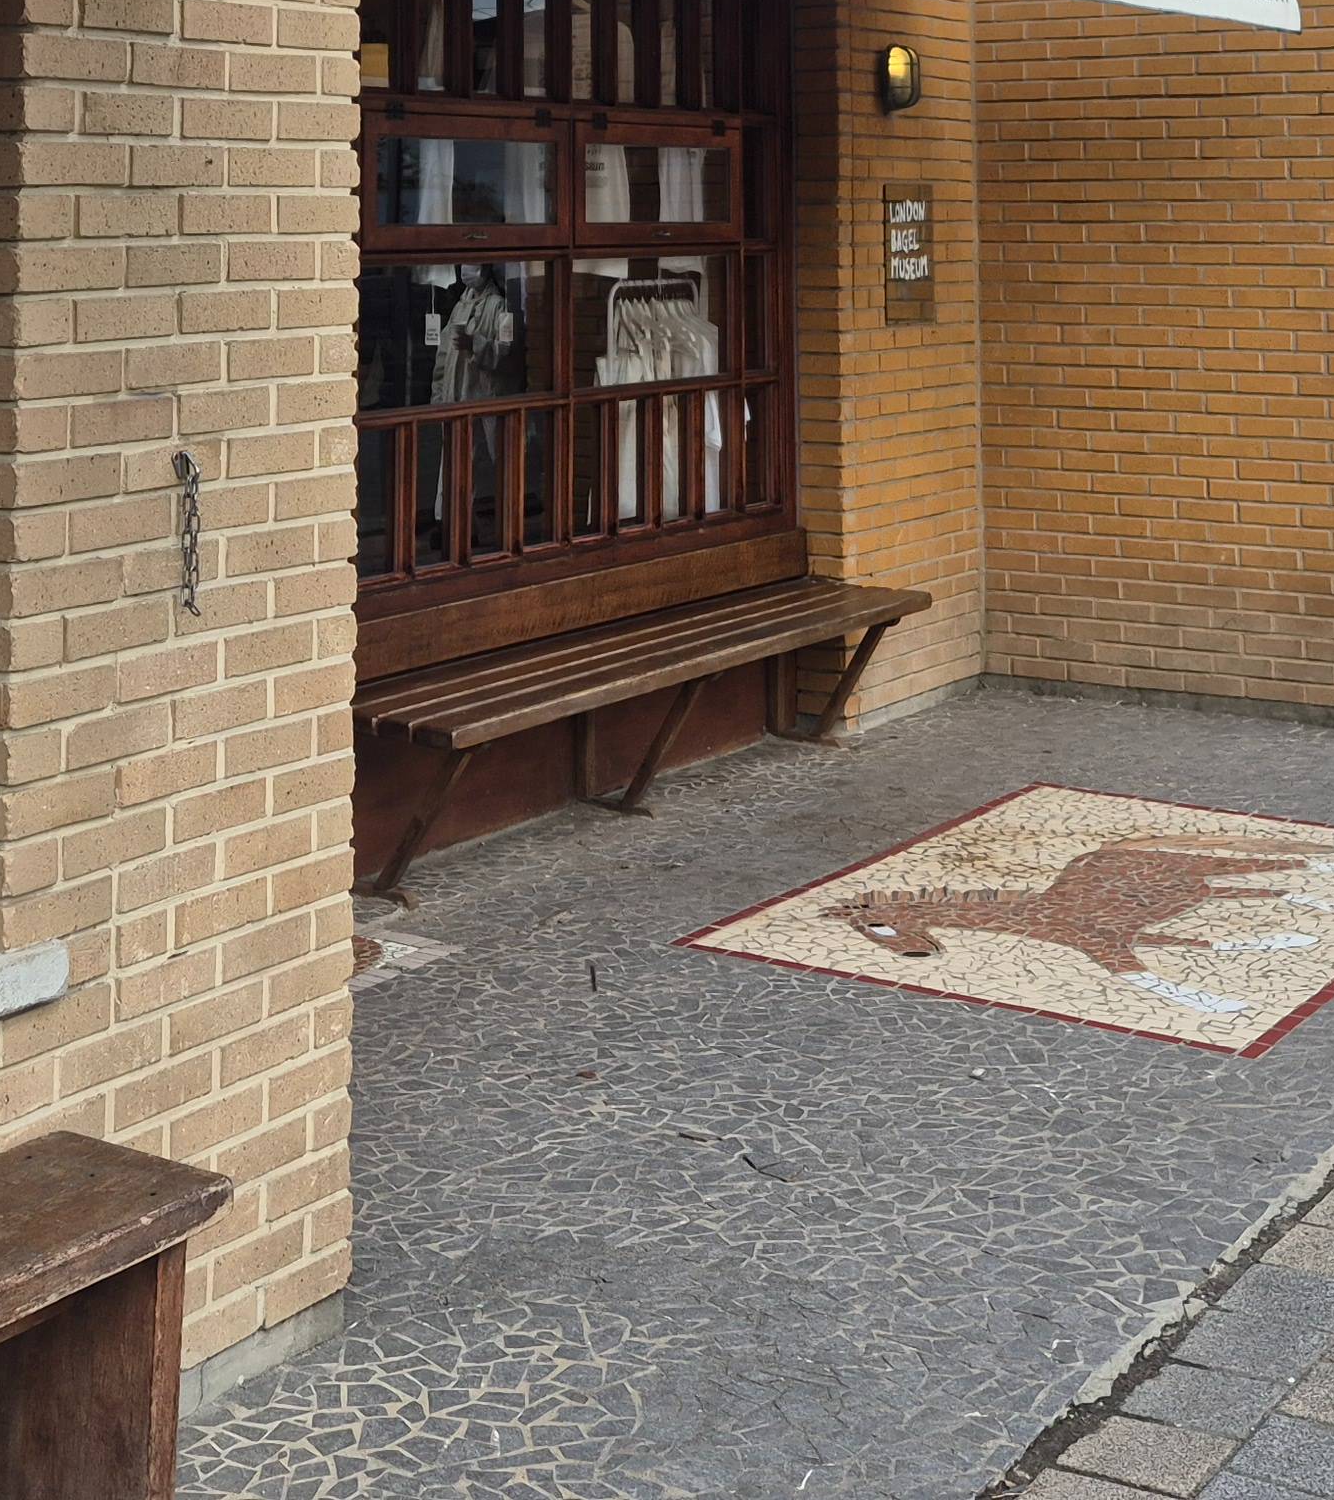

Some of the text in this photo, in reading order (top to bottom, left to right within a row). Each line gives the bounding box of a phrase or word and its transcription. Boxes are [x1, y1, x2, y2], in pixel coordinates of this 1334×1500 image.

[889, 199, 926, 224] LONDON
[890, 228, 920, 254] BAGEL
[891, 254, 929, 281] MUSEUM
